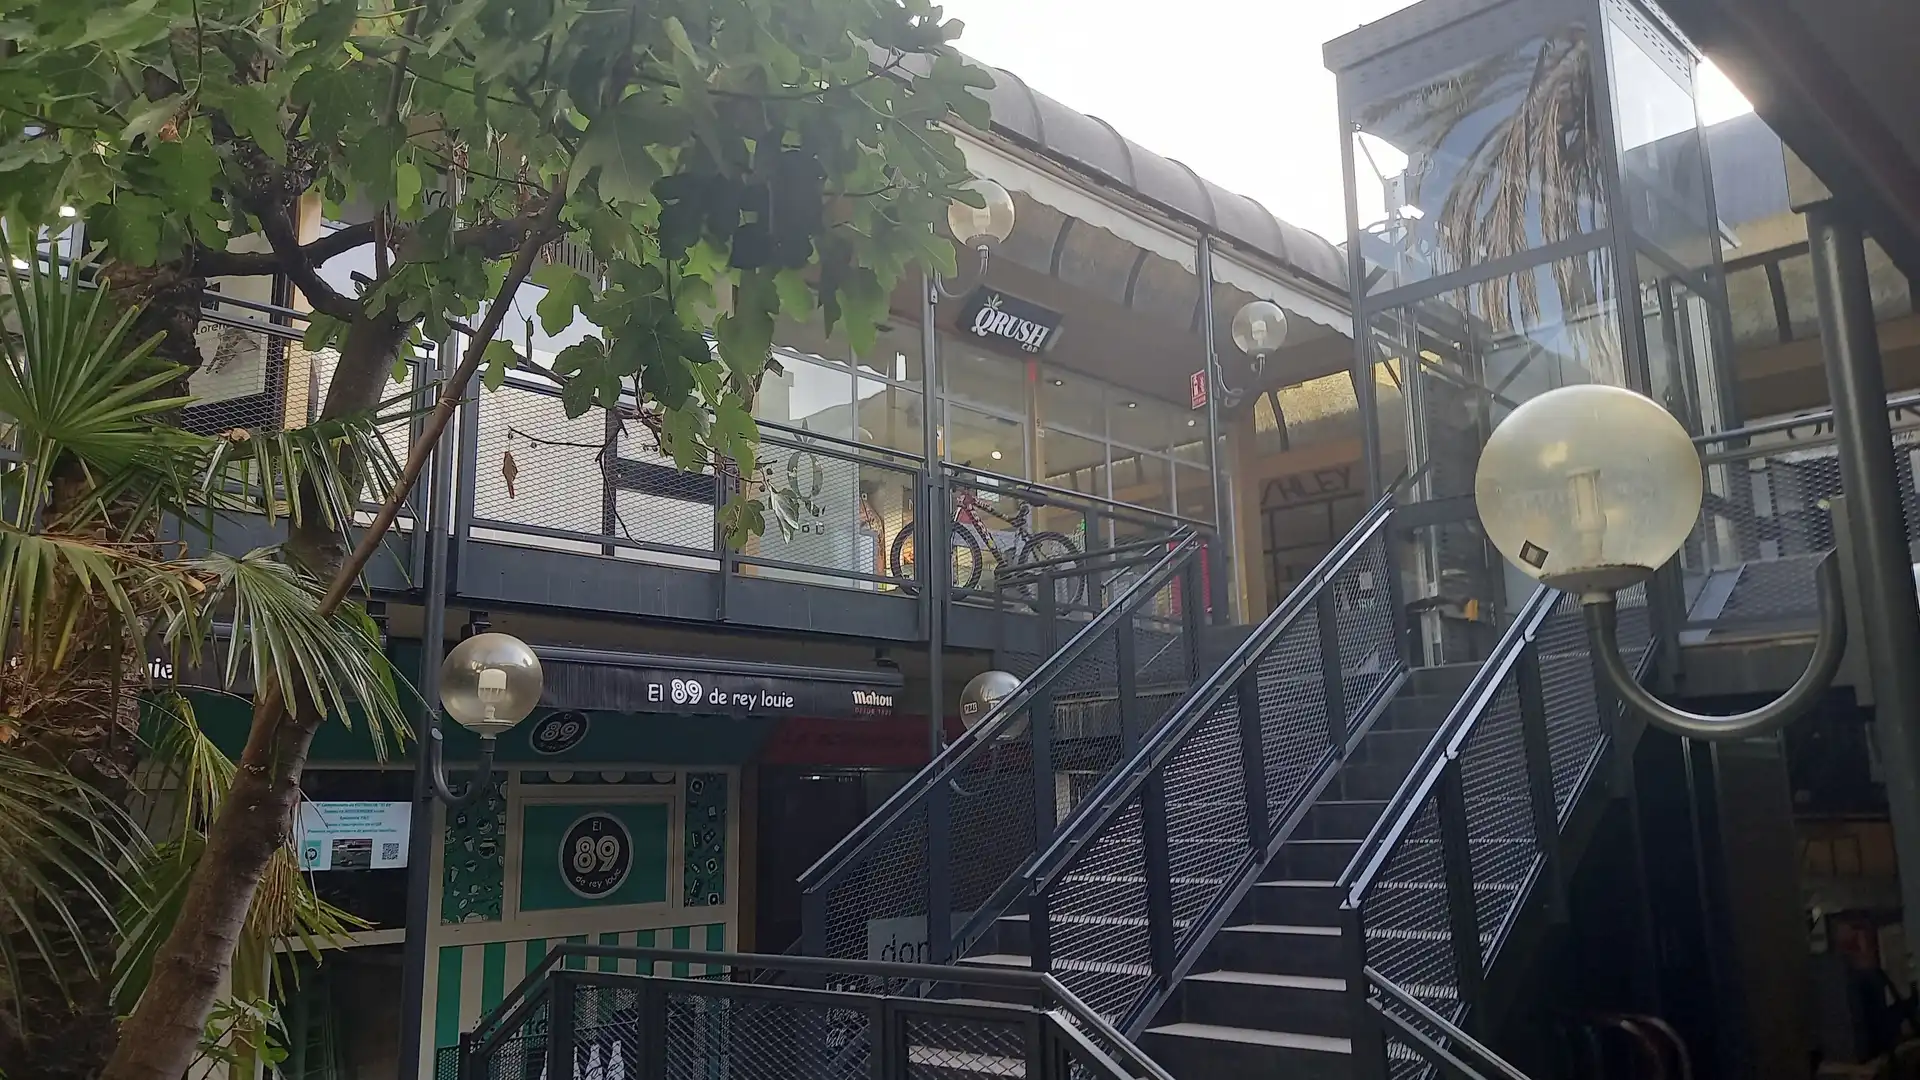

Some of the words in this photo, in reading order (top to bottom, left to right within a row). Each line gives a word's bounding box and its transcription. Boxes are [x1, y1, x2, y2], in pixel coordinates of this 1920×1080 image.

[971, 307, 1050, 347] QRUSH
[648, 683, 663, 701] El
[671, 678, 702, 704] 89
[708, 688, 727, 705] de
[732, 694, 757, 711] rey
[761, 691, 794, 708] louie
[852, 690, 893, 707] Mahou
[541, 722, 580, 741] 89
[592, 820, 602, 831] El
[573, 836, 620, 874] 89
